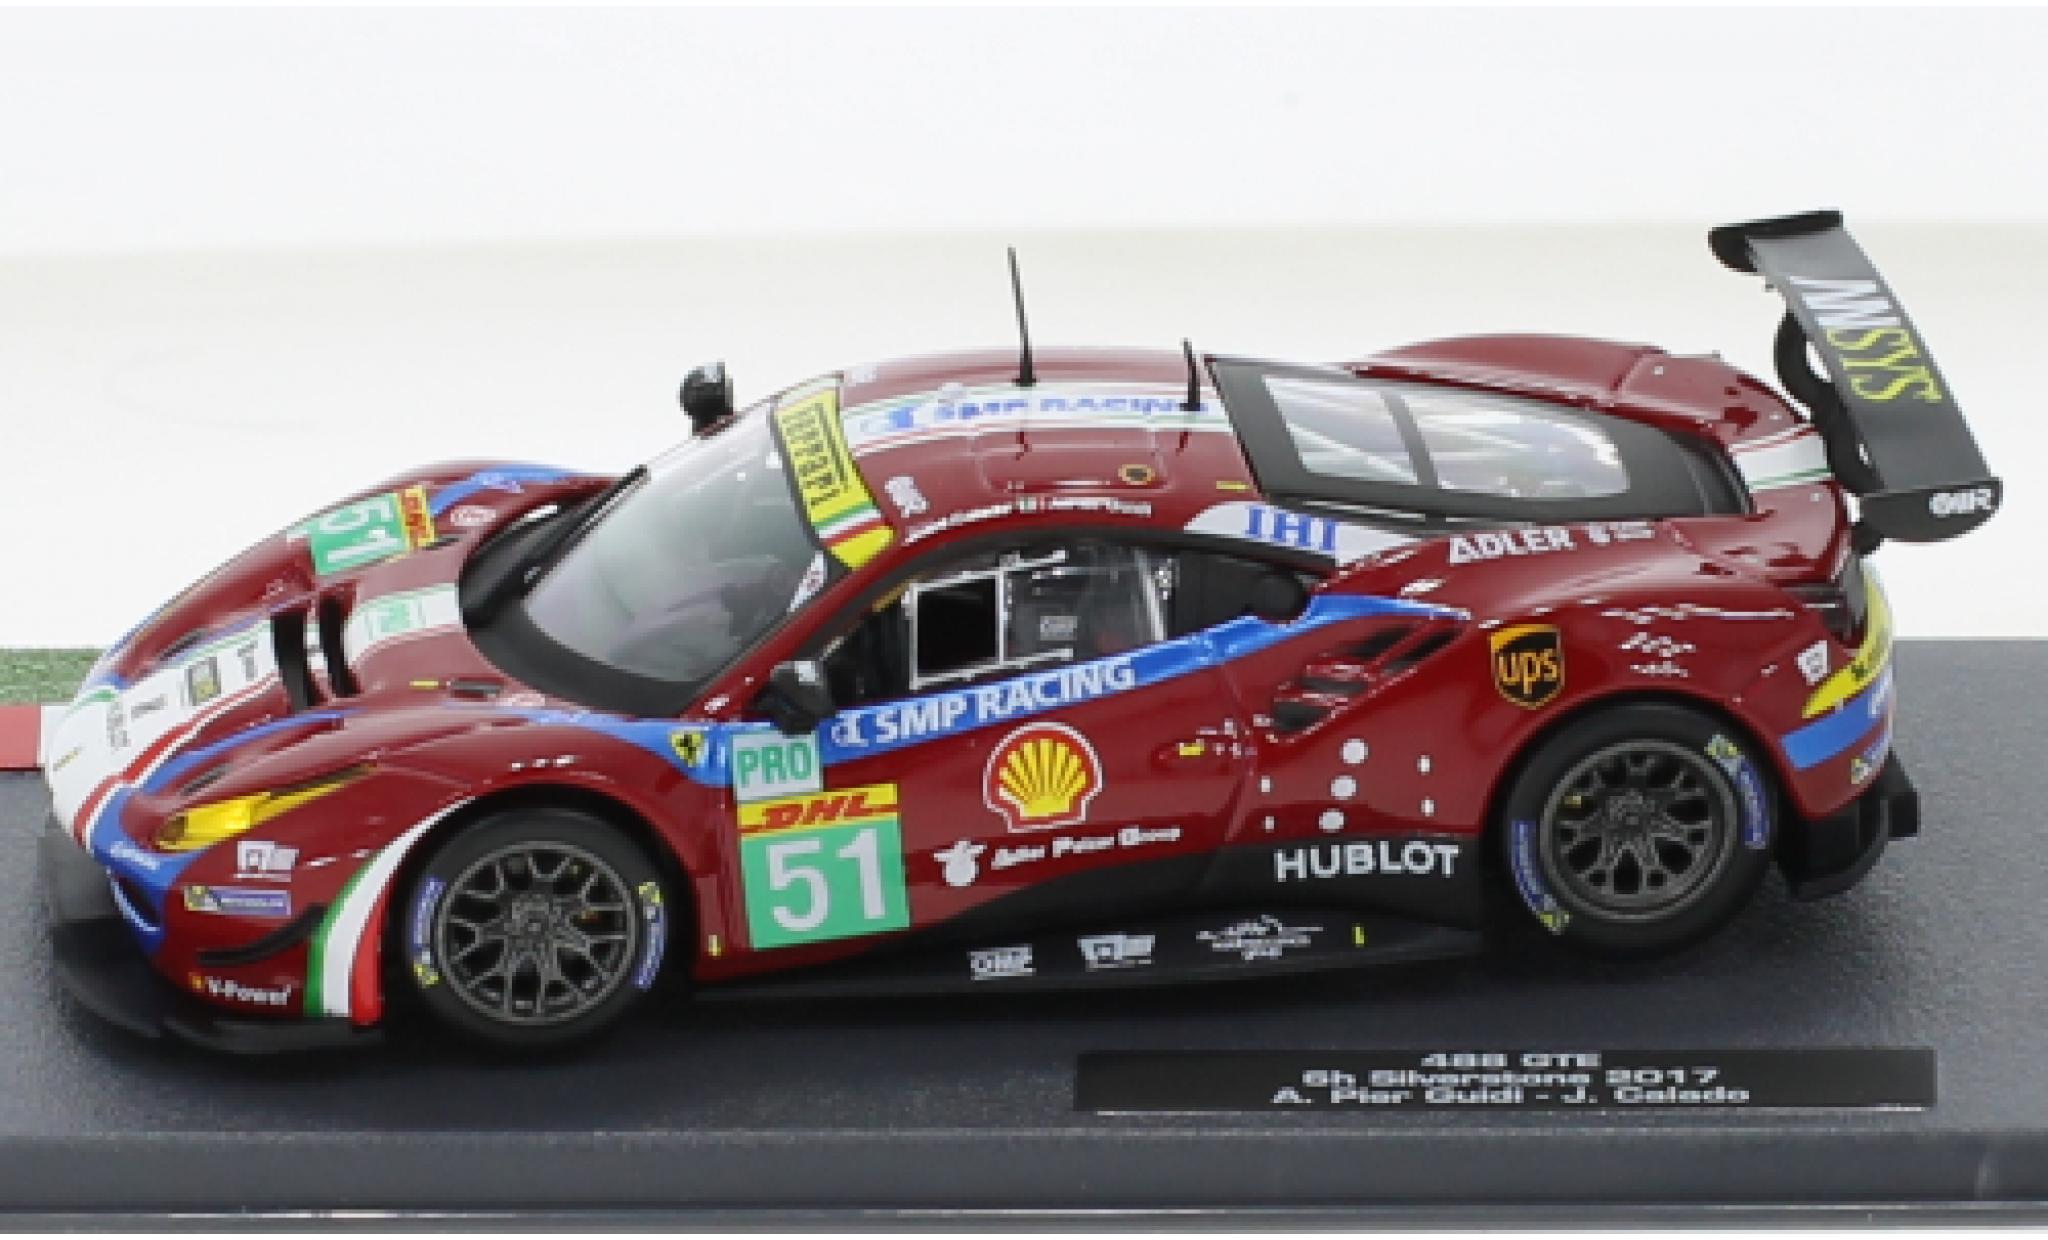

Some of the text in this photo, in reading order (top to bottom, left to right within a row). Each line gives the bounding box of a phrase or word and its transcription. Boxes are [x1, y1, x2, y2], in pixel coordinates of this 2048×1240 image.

[1245, 507, 1338, 551] IHI
[1448, 525, 1577, 567] ADLER
[1497, 649, 1559, 697] ups
[875, 661, 1136, 744] SMP RACING
[737, 742, 812, 788] PRO
[762, 792, 872, 829] DHL
[766, 828, 886, 932] 51
[1274, 842, 1461, 882] HUBLOT
[1605, 1066, 1720, 1085] 2017
